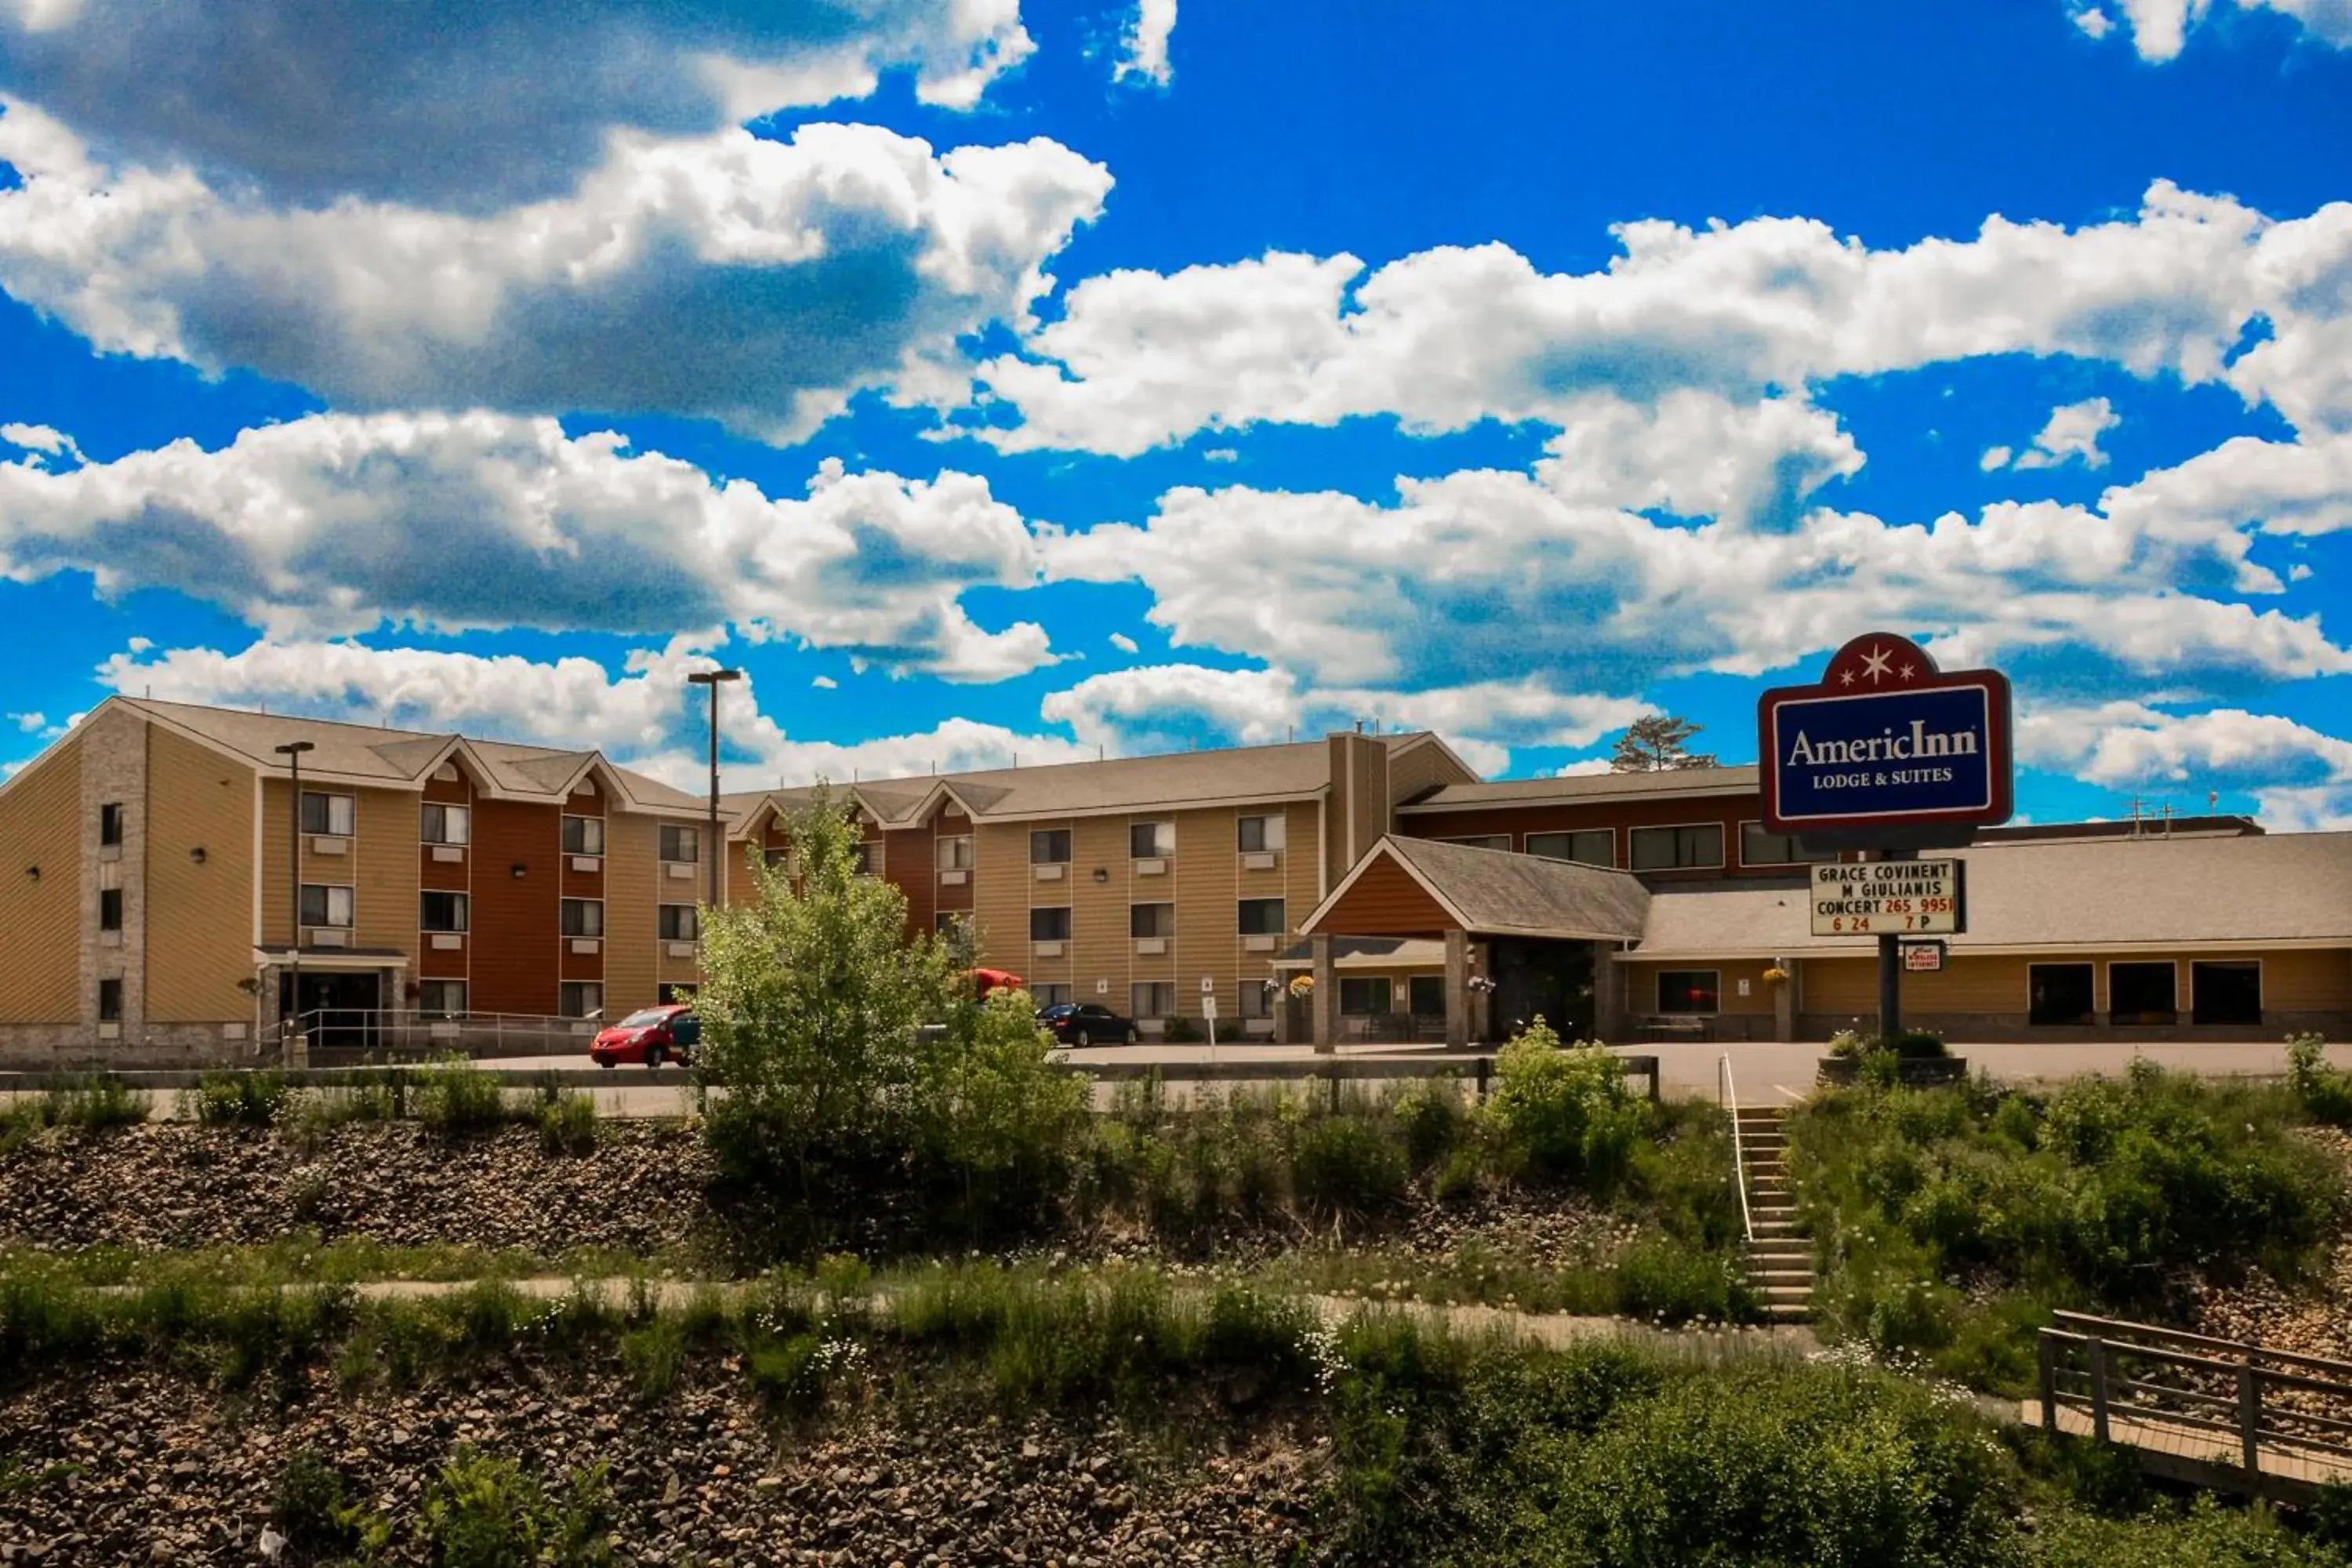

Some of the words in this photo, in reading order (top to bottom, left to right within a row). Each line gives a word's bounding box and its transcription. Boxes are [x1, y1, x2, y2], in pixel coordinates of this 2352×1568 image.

[1787, 720, 1978, 766] AmericInn
[1813, 773, 1870, 789] LODGE
[1875, 772, 1888, 786] &
[1891, 768, 1953, 784] SUITES
[1819, 867, 1867, 882] GRACE
[1861, 880, 1942, 897] GIULIANIS
[1817, 899, 1881, 915] CONCERT
[1886, 899, 1911, 913] 265
[1921, 898, 1954, 912] 9951
[1833, 917, 1842, 931] 6
[1852, 917, 1869, 930] 24
[1906, 916, 1914, 928] 7
[1920, 915, 1930, 928] P
